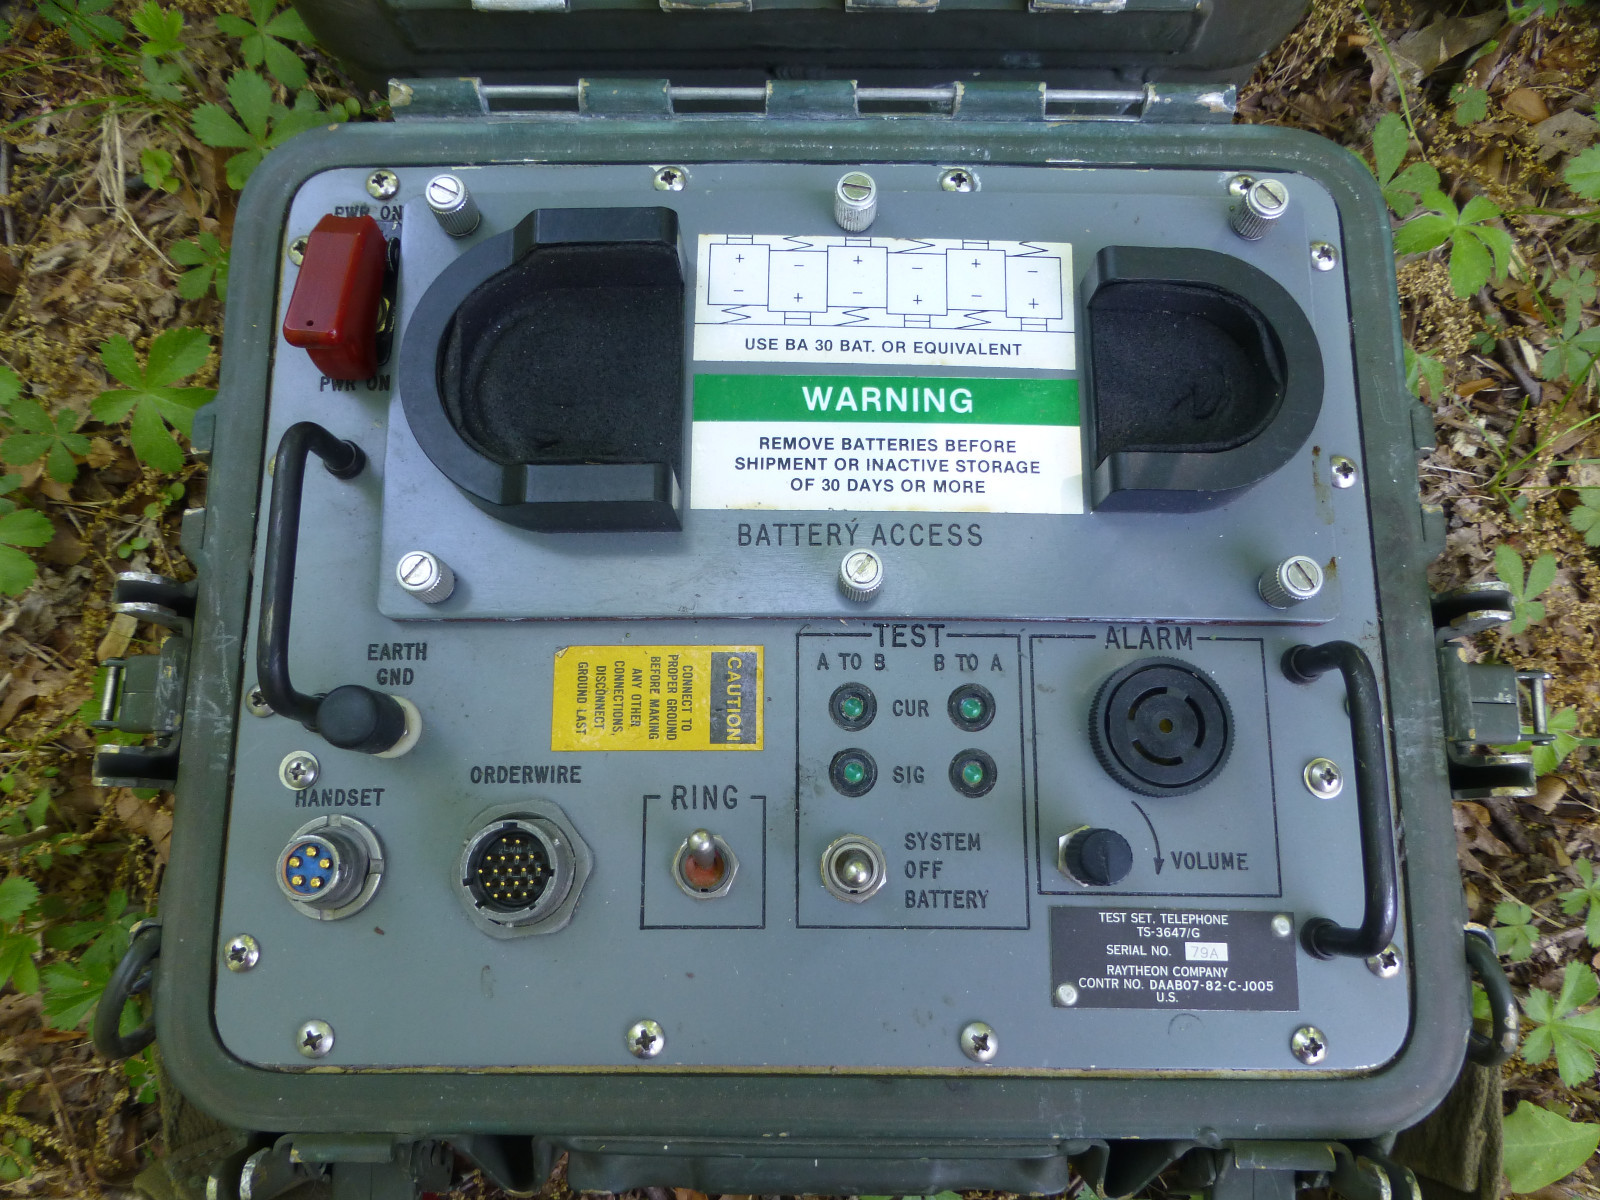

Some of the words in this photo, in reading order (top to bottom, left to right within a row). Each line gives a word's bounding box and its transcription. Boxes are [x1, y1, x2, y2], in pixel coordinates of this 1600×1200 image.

[334, 205, 370, 218] PWR
[380, 205, 404, 220] ON
[745, 338, 779, 351] USE
[785, 339, 808, 352] BA
[815, 339, 833, 352] 30
[840, 340, 875, 353] BAT.
[881, 340, 906, 354] OR
[913, 341, 1022, 356] EQUIVALENT
[319, 376, 356, 392] PWR
[367, 374, 391, 392] ON
[802, 386, 973, 413] WARNING
[759, 436, 835, 451] REMOVE
[841, 437, 938, 452] BATTERIES
[945, 439, 1017, 453] BEFORE
[734, 457, 827, 471] SHIPMENT
[834, 458, 859, 472] OR
[866, 458, 949, 473] INACTIVE
[955, 459, 1041, 475] STORAGE
[790, 478, 815, 492] OF
[821, 478, 841, 492] 30
[847, 478, 895, 493] DAYS
[900, 479, 926, 493] OR
[933, 480, 986, 494] MORE
[737, 522, 860, 546] BATTERY
[871, 523, 983, 547] ACCESS
[873, 623, 945, 648] TEST
[1104, 625, 1193, 651] ALARM
[367, 642, 428, 661] EARTH
[816, 653, 829, 670] A
[838, 653, 862, 670] TO
[874, 653, 886, 671] B
[934, 654, 945, 671] B
[955, 654, 979, 671] TO
[990, 654, 1003, 671] A
[376, 667, 414, 686] GND
[576, 661, 589, 704] GROUND
[631, 668, 643, 689] ANY
[649, 656, 661, 694] BEFORE
[667, 654, 680, 694] PROPER
[594, 665, 607, 729] DISCONNECT
[681, 665, 694, 714] CONNECT
[726, 656, 742, 742] CAUTION
[630, 693, 642, 728] OTHER
[892, 699, 929, 717] CUR
[575, 709, 587, 735] LAST
[648, 699, 660, 740] MAKING
[666, 698, 678, 741] GROUND
[681, 718, 693, 732] TO
[470, 765, 582, 784] ORDERWIRE
[892, 766, 925, 784] SIG
[295, 788, 385, 808] HANDSET
[671, 785, 738, 810] RING
[904, 832, 981, 851] SYSTEM
[904, 860, 943, 879] OFF
[1170, 850, 1249, 870] VOLUME
[905, 890, 989, 909] BATTERY
[1099, 912, 1127, 923] TEST
[1160, 913, 1229, 925] TELEPHONE
[1136, 926, 1200, 938] TS-3647/G
[1106, 944, 1148, 956] SERIAL
[1151, 945, 1172, 956] NO.
[1191, 945, 1219, 959] 79A
[1106, 964, 1168, 977] RAYTHEON
[1172, 966, 1228, 978] COMPANY
[1078, 977, 1119, 989] CONTR
[1123, 978, 1144, 989] NO.
[1156, 991, 1179, 1003] U.S.
